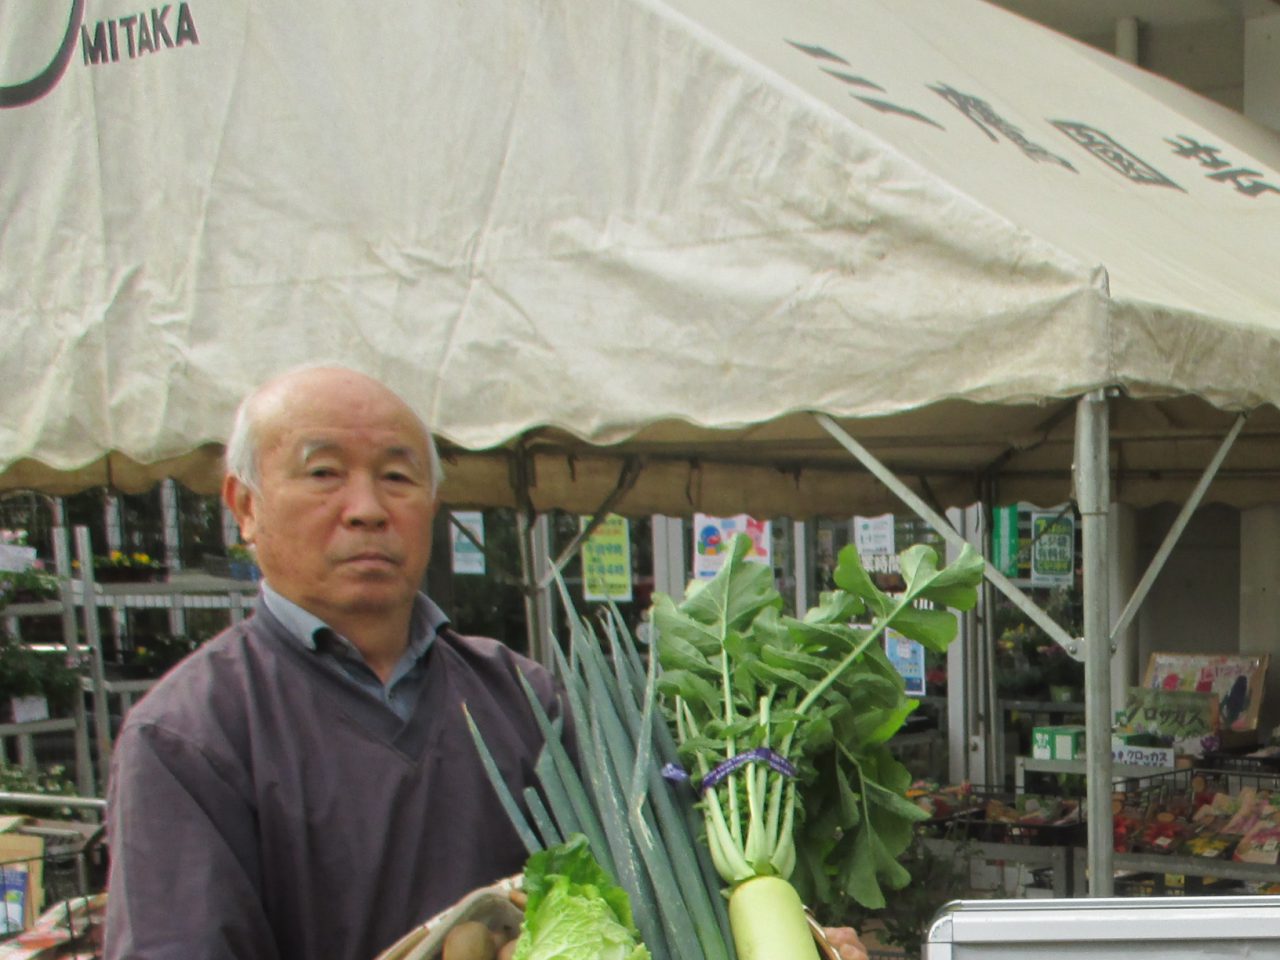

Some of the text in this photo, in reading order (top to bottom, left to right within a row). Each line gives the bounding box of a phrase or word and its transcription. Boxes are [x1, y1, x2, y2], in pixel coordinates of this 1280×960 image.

[81, 2, 200, 66] MITAKA
[1127, 751, 1168, 762] クロッカス
